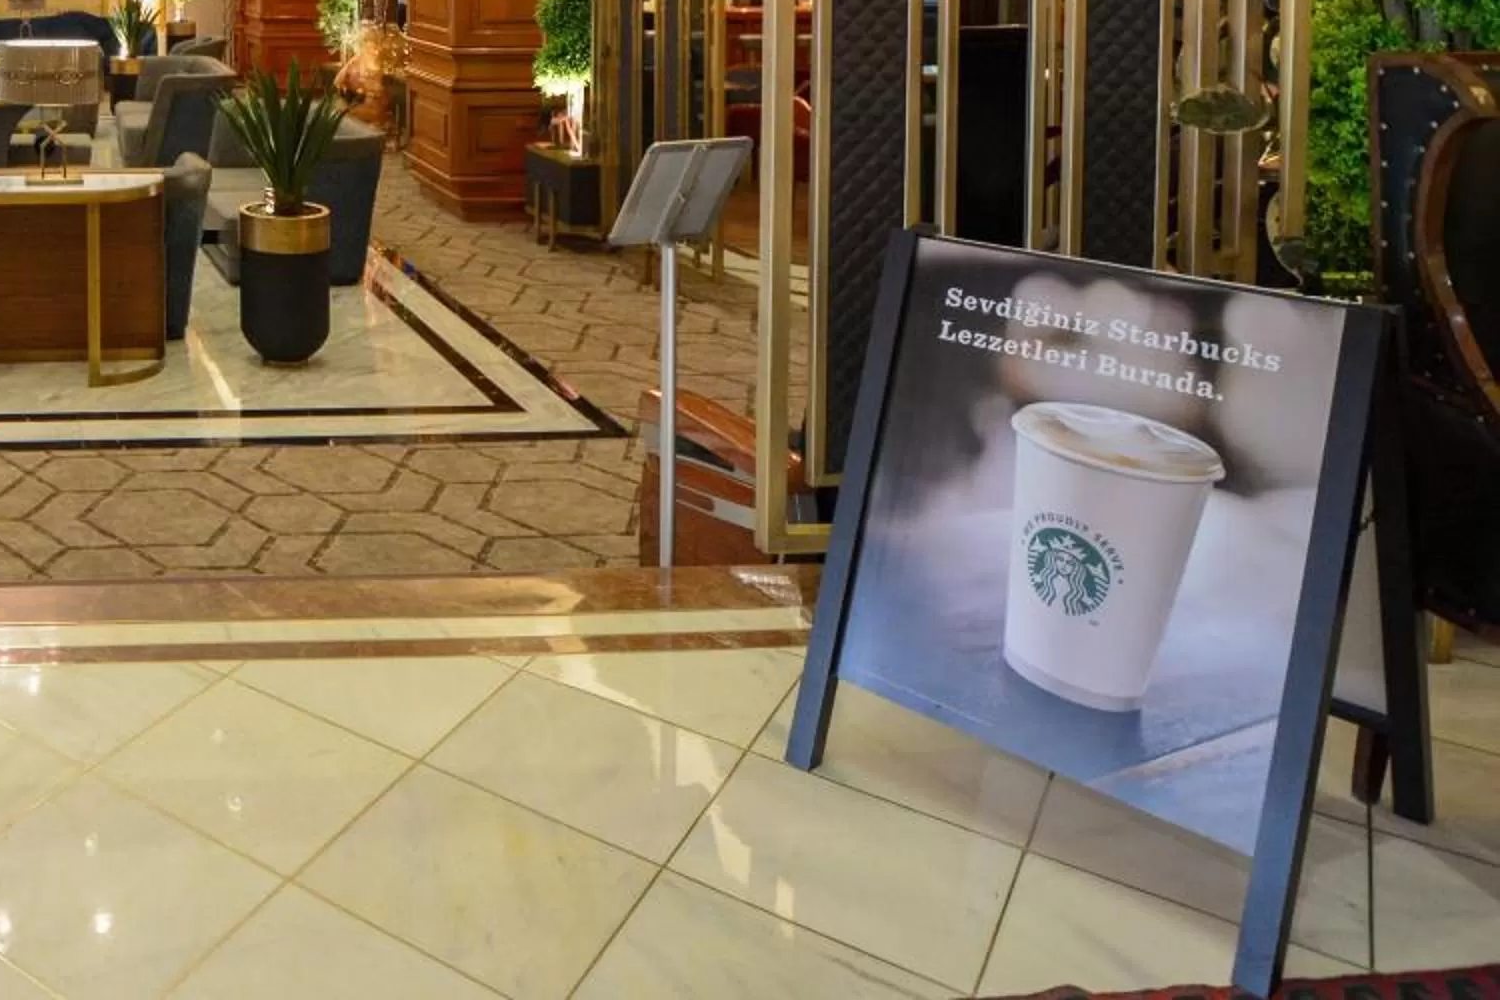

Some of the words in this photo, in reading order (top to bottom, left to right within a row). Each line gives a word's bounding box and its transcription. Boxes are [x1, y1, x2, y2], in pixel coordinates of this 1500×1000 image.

[938, 319, 1089, 371] Lezzetleri
[1094, 353, 1224, 401] Burada.
[944, 287, 1100, 337] Sevdiğiniz
[1107, 318, 1282, 373] Starbucks
